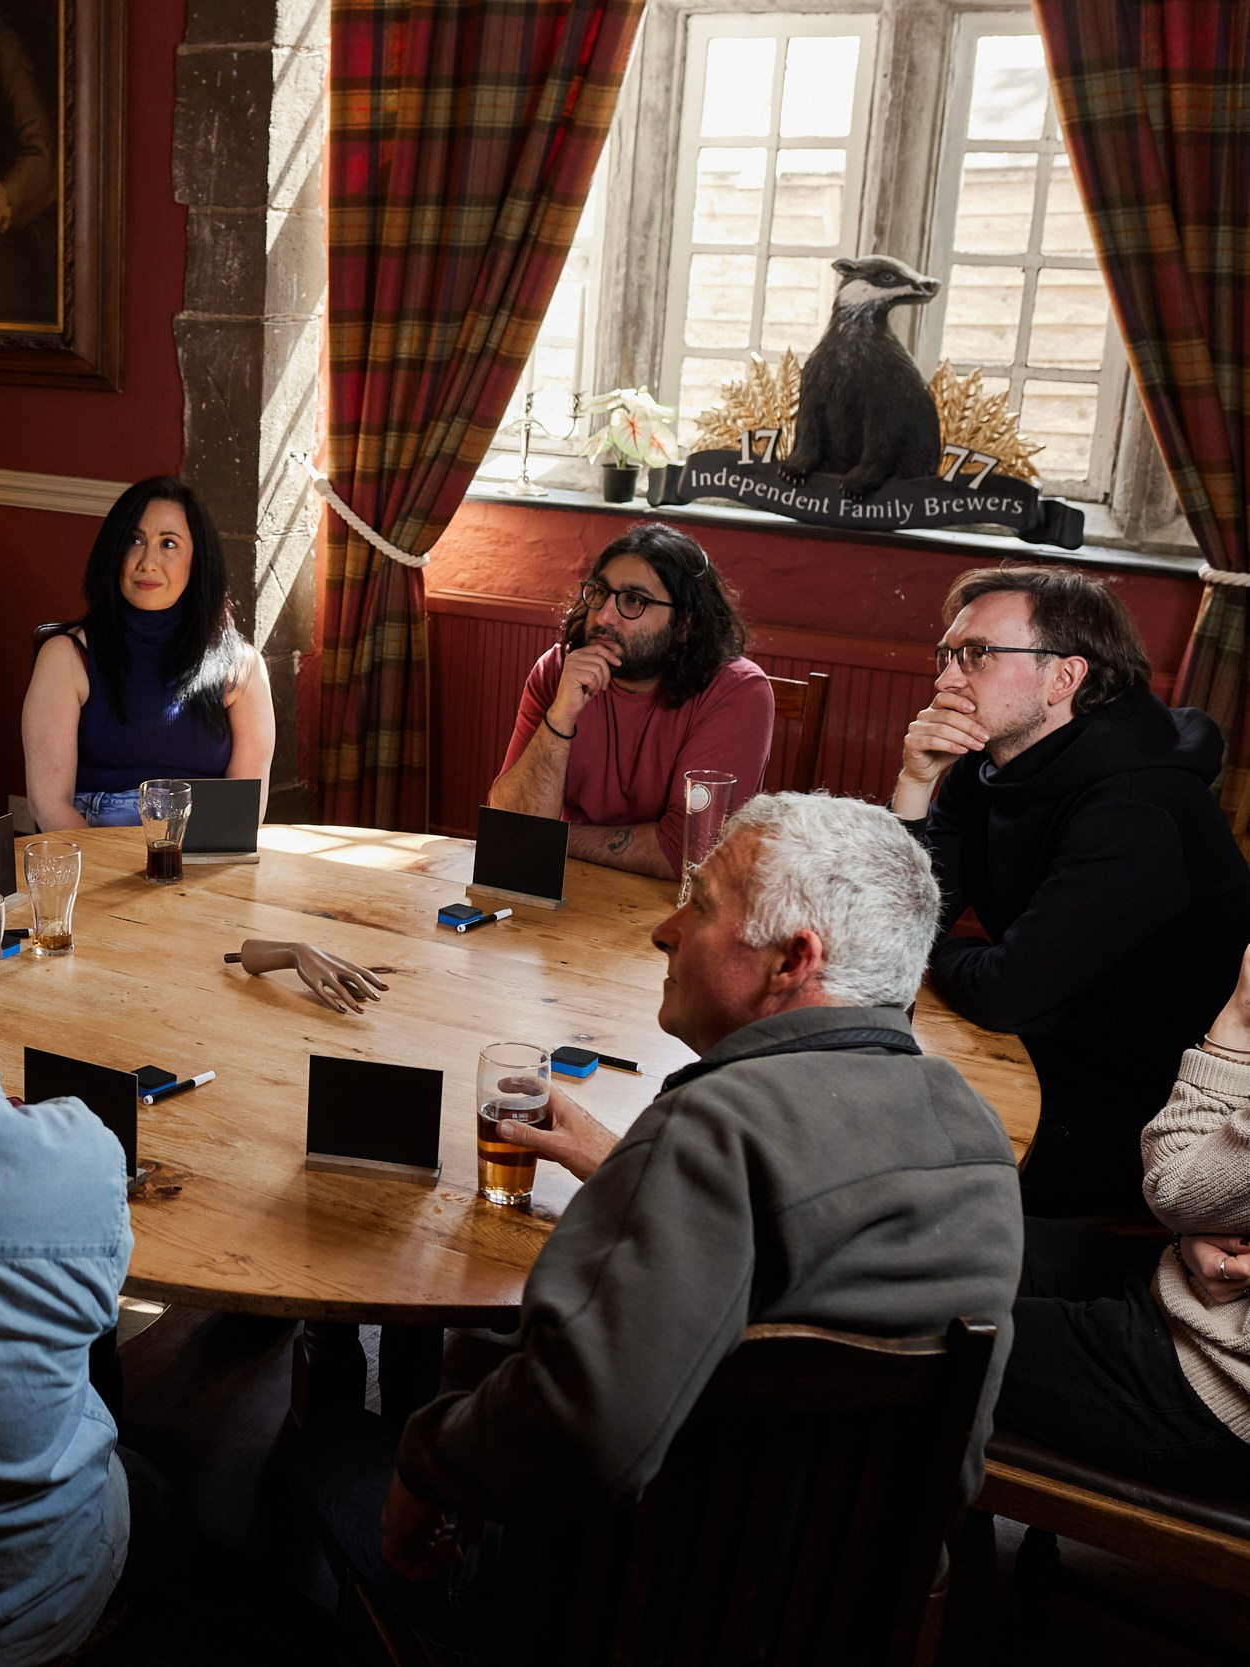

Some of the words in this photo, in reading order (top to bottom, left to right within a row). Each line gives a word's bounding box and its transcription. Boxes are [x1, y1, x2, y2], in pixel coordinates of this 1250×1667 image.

[737, 429, 779, 465] 17
[943, 445, 999, 490] 77
[691, 467, 830, 514] Independent
[839, 499, 913, 525] Family
[924, 496, 1024, 516] Brewers
